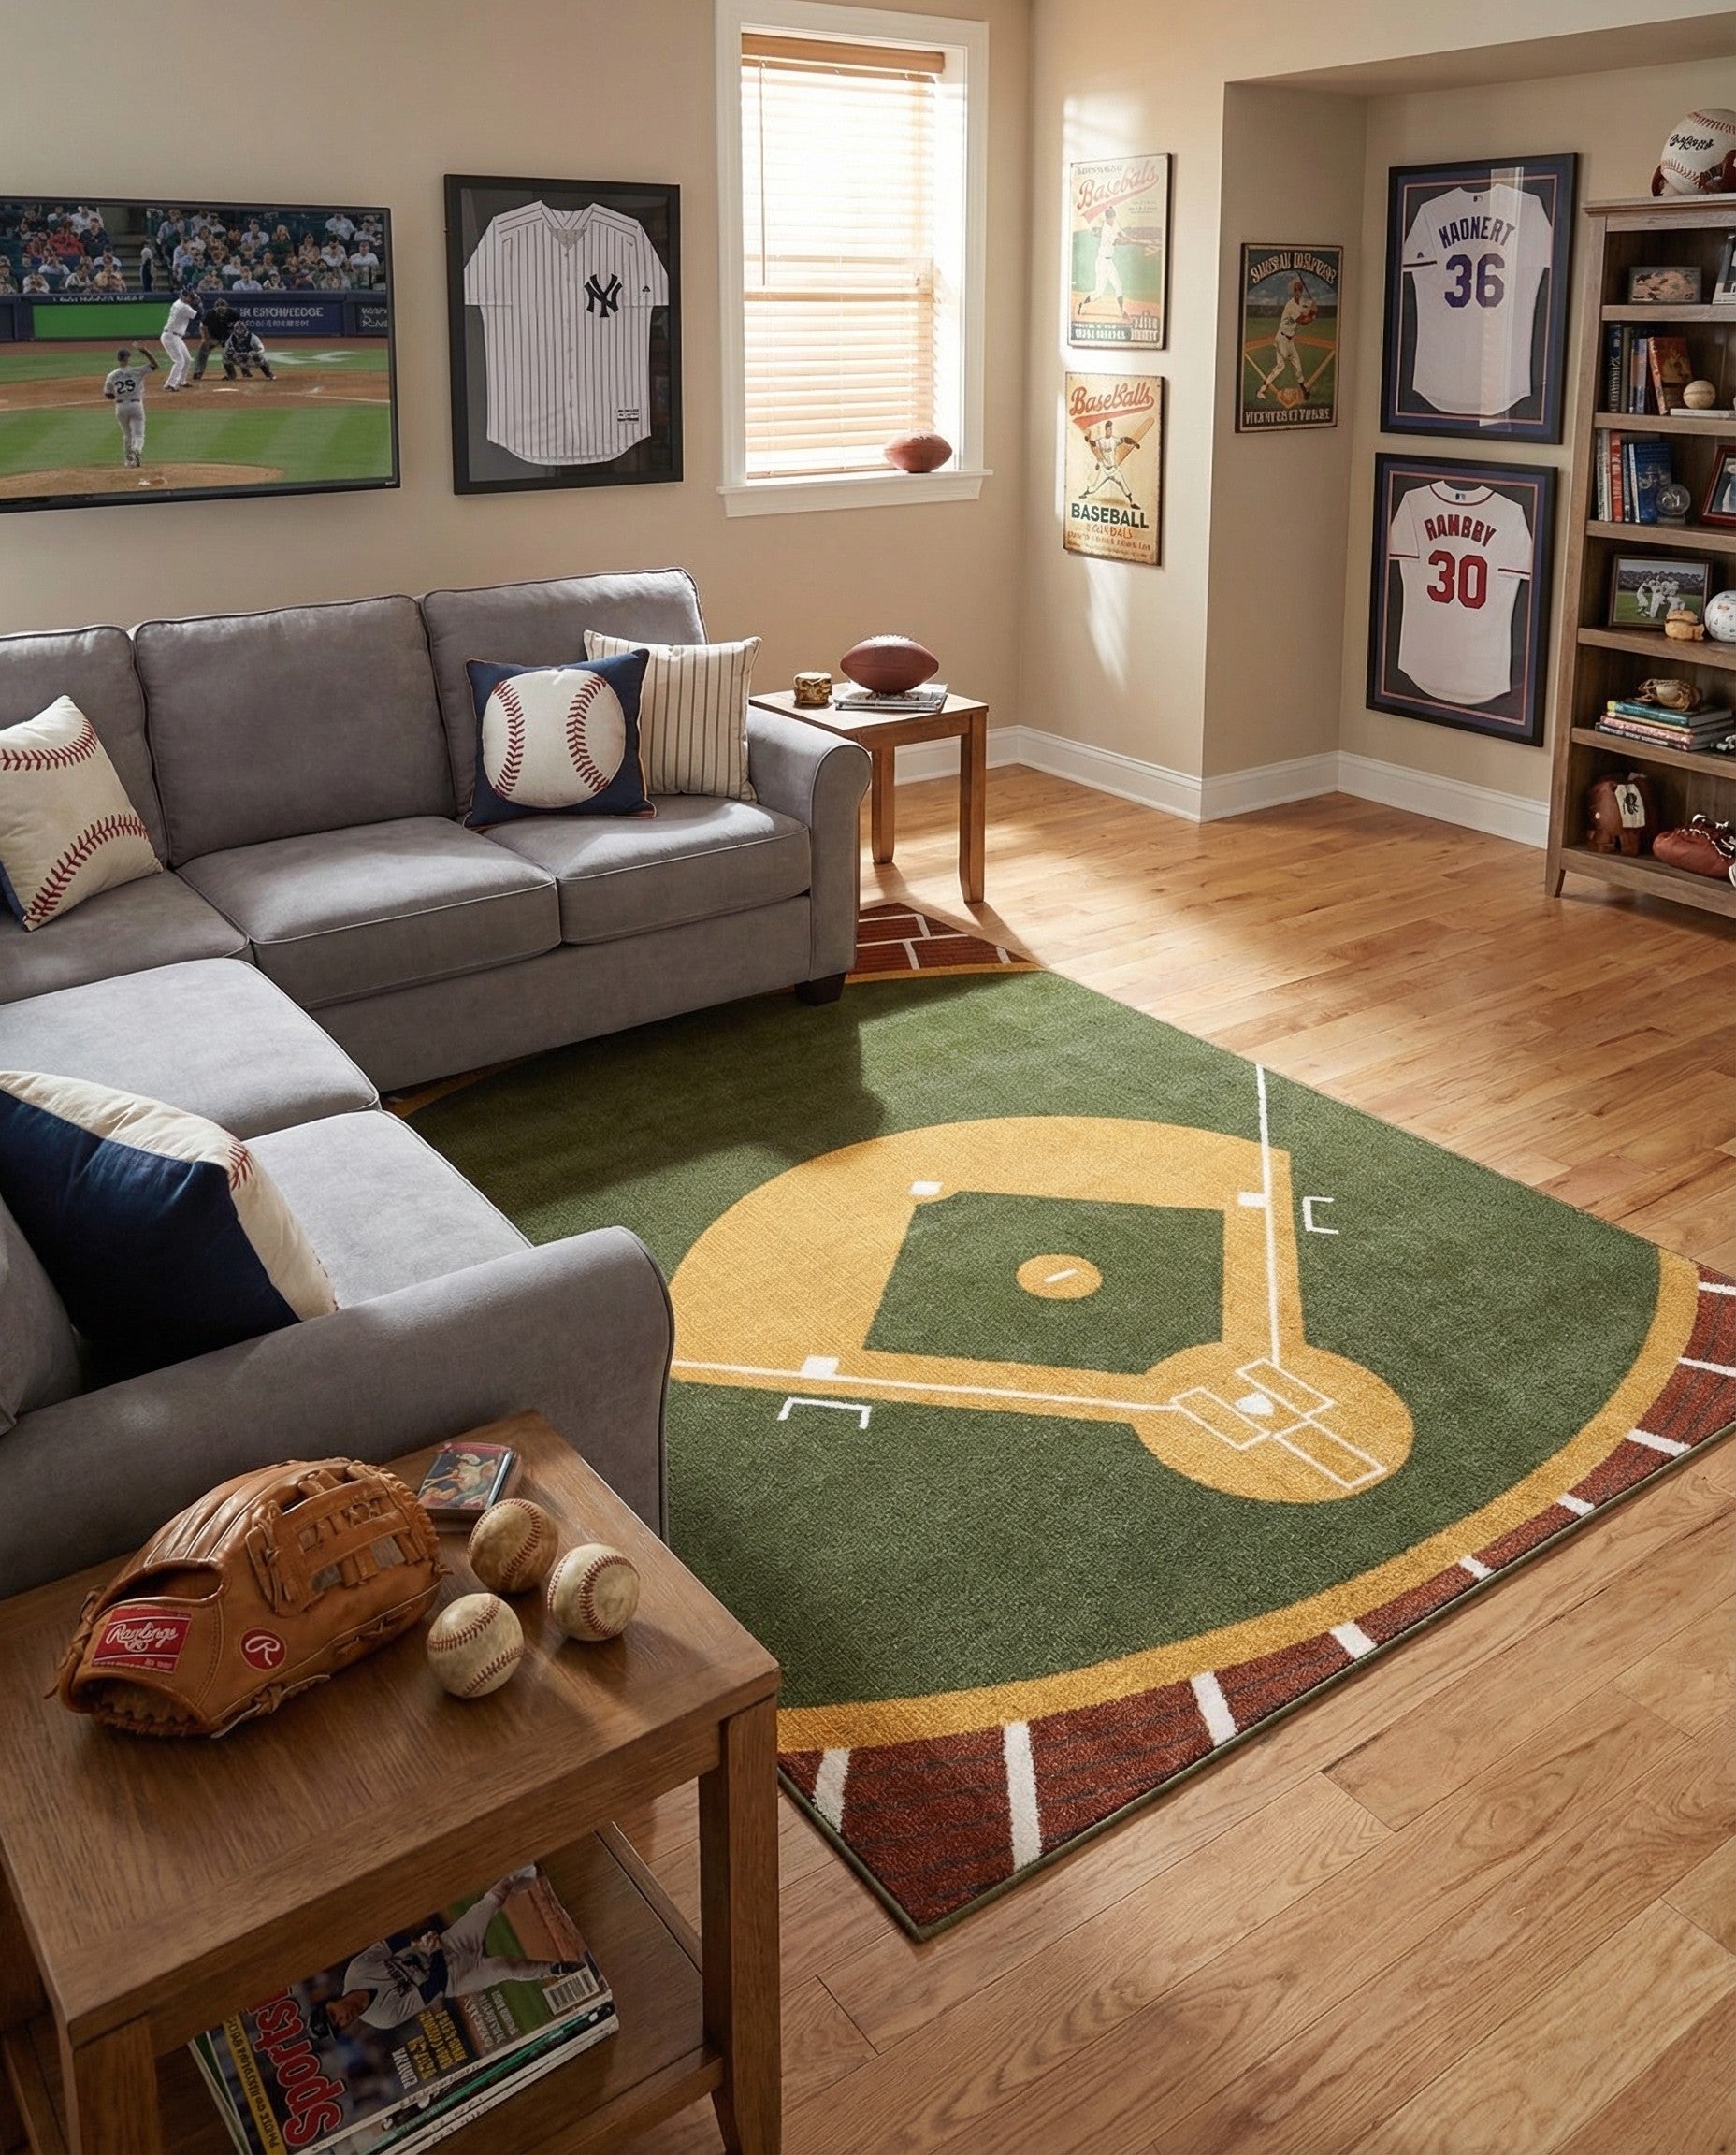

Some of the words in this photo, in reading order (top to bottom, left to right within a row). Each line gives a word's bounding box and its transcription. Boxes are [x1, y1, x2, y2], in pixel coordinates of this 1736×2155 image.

[583, 272, 624, 319] NY
[1444, 253, 1506, 309] 36
[1071, 502, 1150, 529] BASEBALL
[1426, 548, 1488, 610] 30
[245, 1635, 281, 1666] R
